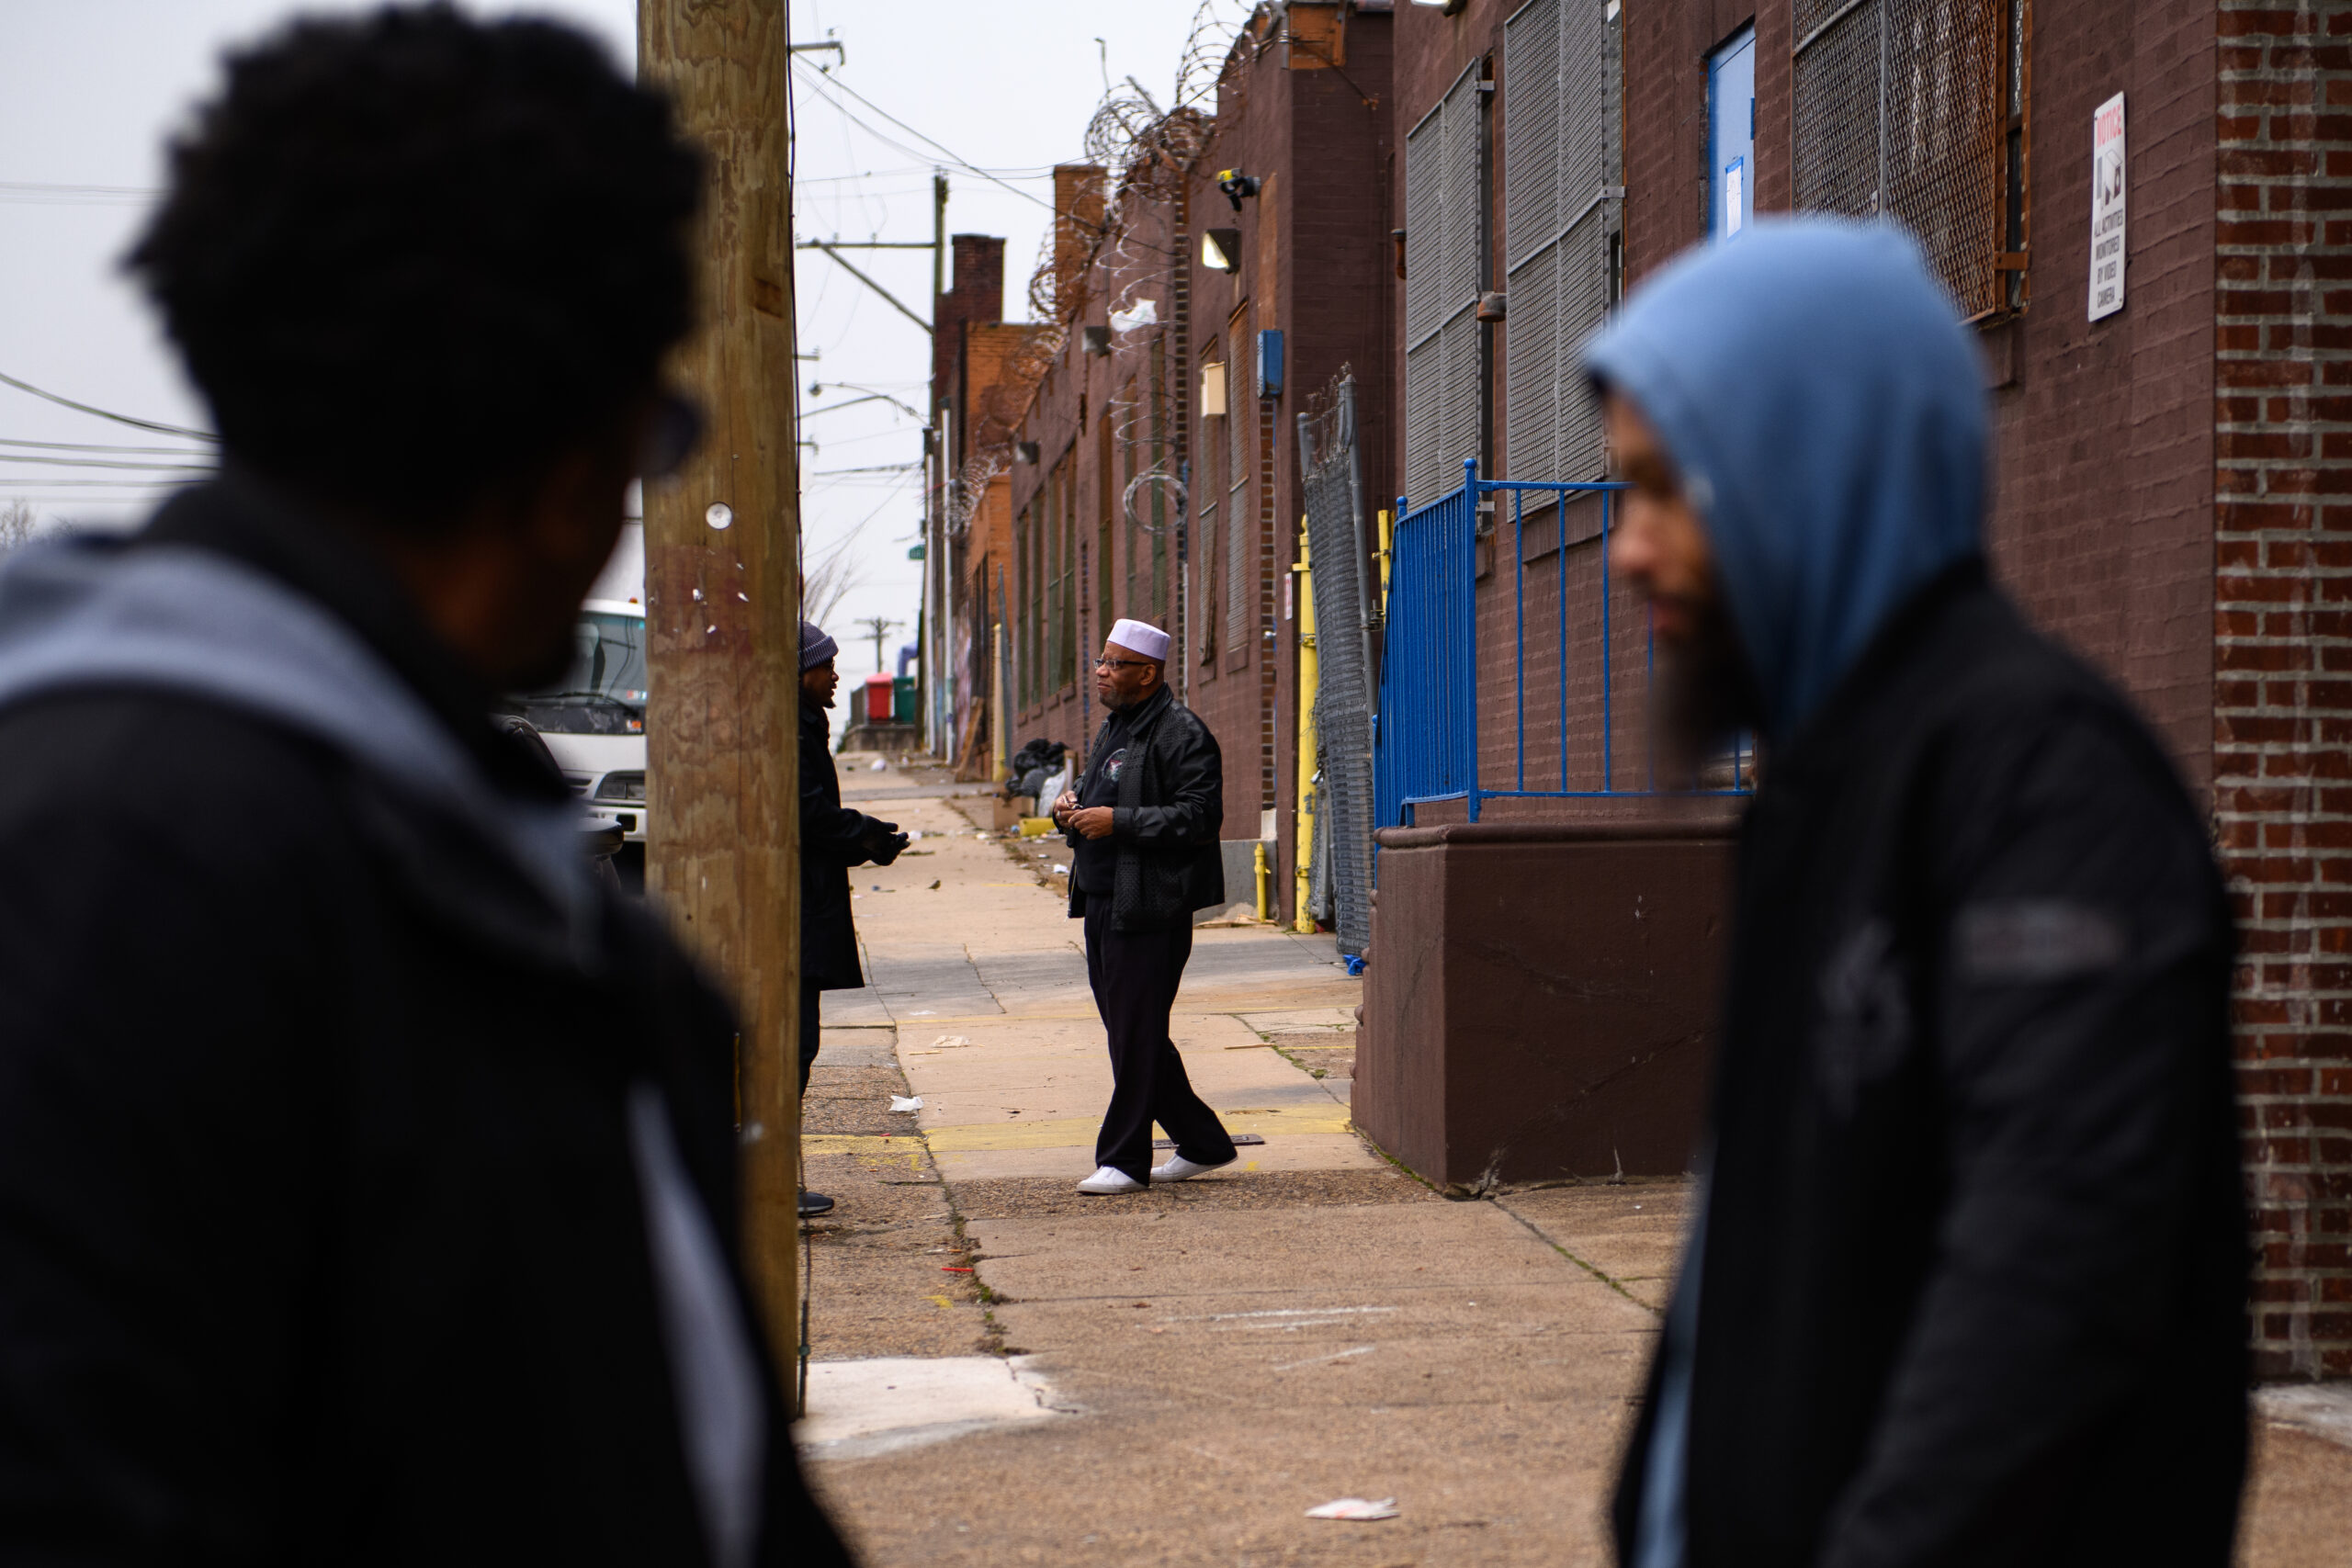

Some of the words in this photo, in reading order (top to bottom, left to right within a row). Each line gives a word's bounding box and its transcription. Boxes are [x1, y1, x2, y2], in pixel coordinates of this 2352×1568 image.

[2097, 103, 2121, 149] NOTICE
[2102, 209, 2123, 234] ACTIVITIES
[2096, 234, 2120, 261] MONITORED
[2098, 266, 2103, 285] BY
[2104, 260, 2117, 281] VIDEO
[2097, 286, 2115, 309] CAMERA
